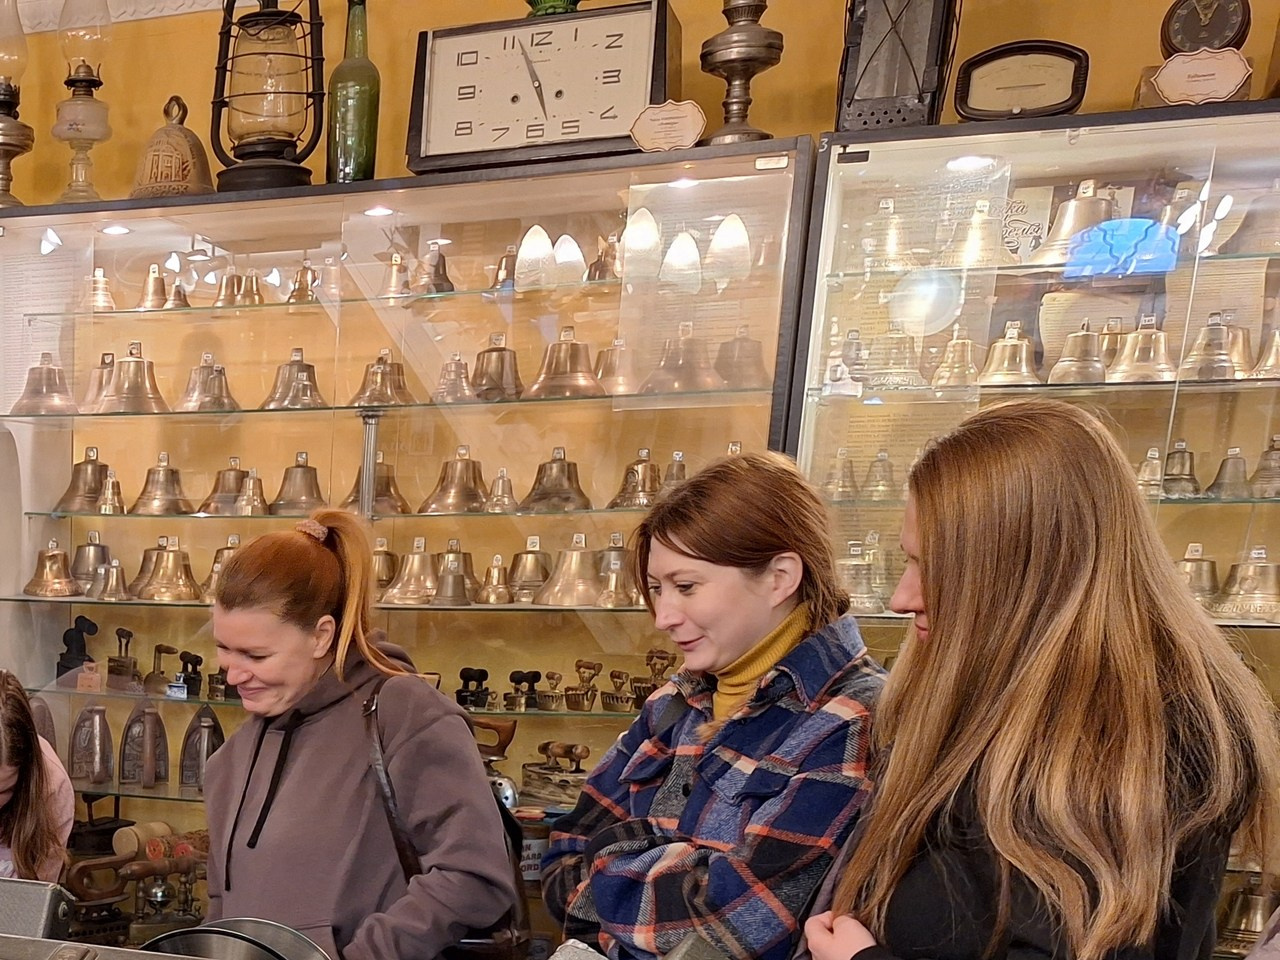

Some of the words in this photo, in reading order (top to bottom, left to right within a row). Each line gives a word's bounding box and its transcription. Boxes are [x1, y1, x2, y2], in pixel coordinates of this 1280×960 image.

[503, 35, 516, 50] 11
[530, 30, 554, 47] 12
[605, 33, 624, 49] 2
[456, 50, 479, 67] 10
[602, 69, 622, 85] 3
[457, 85, 476, 101] 9
[600, 105, 618, 120] 4
[454, 121, 473, 136] 8
[491, 126, 510, 142] 7
[525, 123, 545, 139] 6
[561, 119, 580, 135] 5
[818, 137, 829, 152] 3
